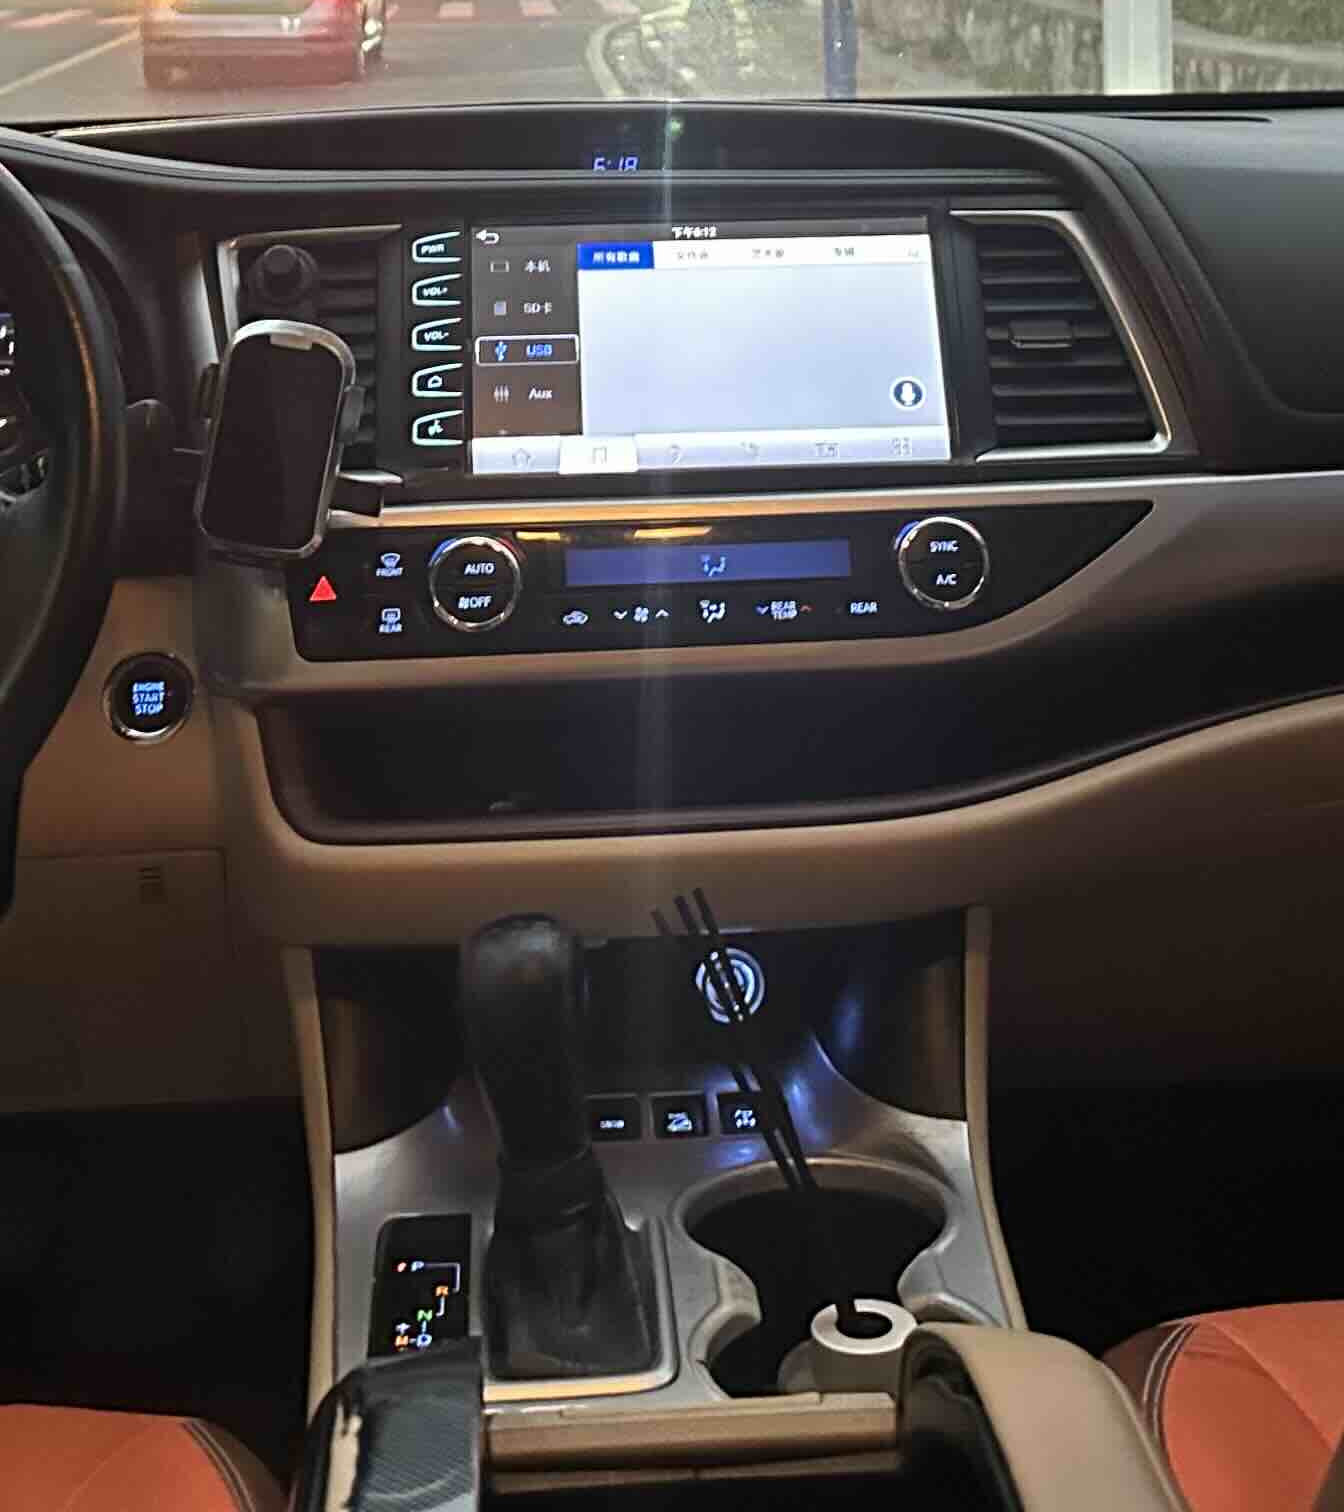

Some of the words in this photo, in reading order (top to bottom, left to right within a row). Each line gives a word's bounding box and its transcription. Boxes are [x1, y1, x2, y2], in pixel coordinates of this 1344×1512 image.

[525, 343, 553, 357] USB
[528, 387, 553, 401] Aux
[929, 539, 959, 553] SYNC
[464, 562, 495, 576] AUTO
[935, 573, 957, 586] A/C
[469, 595, 492, 608] OFF
[849, 601, 878, 614] REAR
[132, 692, 166, 703] START
[135, 703, 165, 716] STOP
[417, 1309, 433, 1321] N
